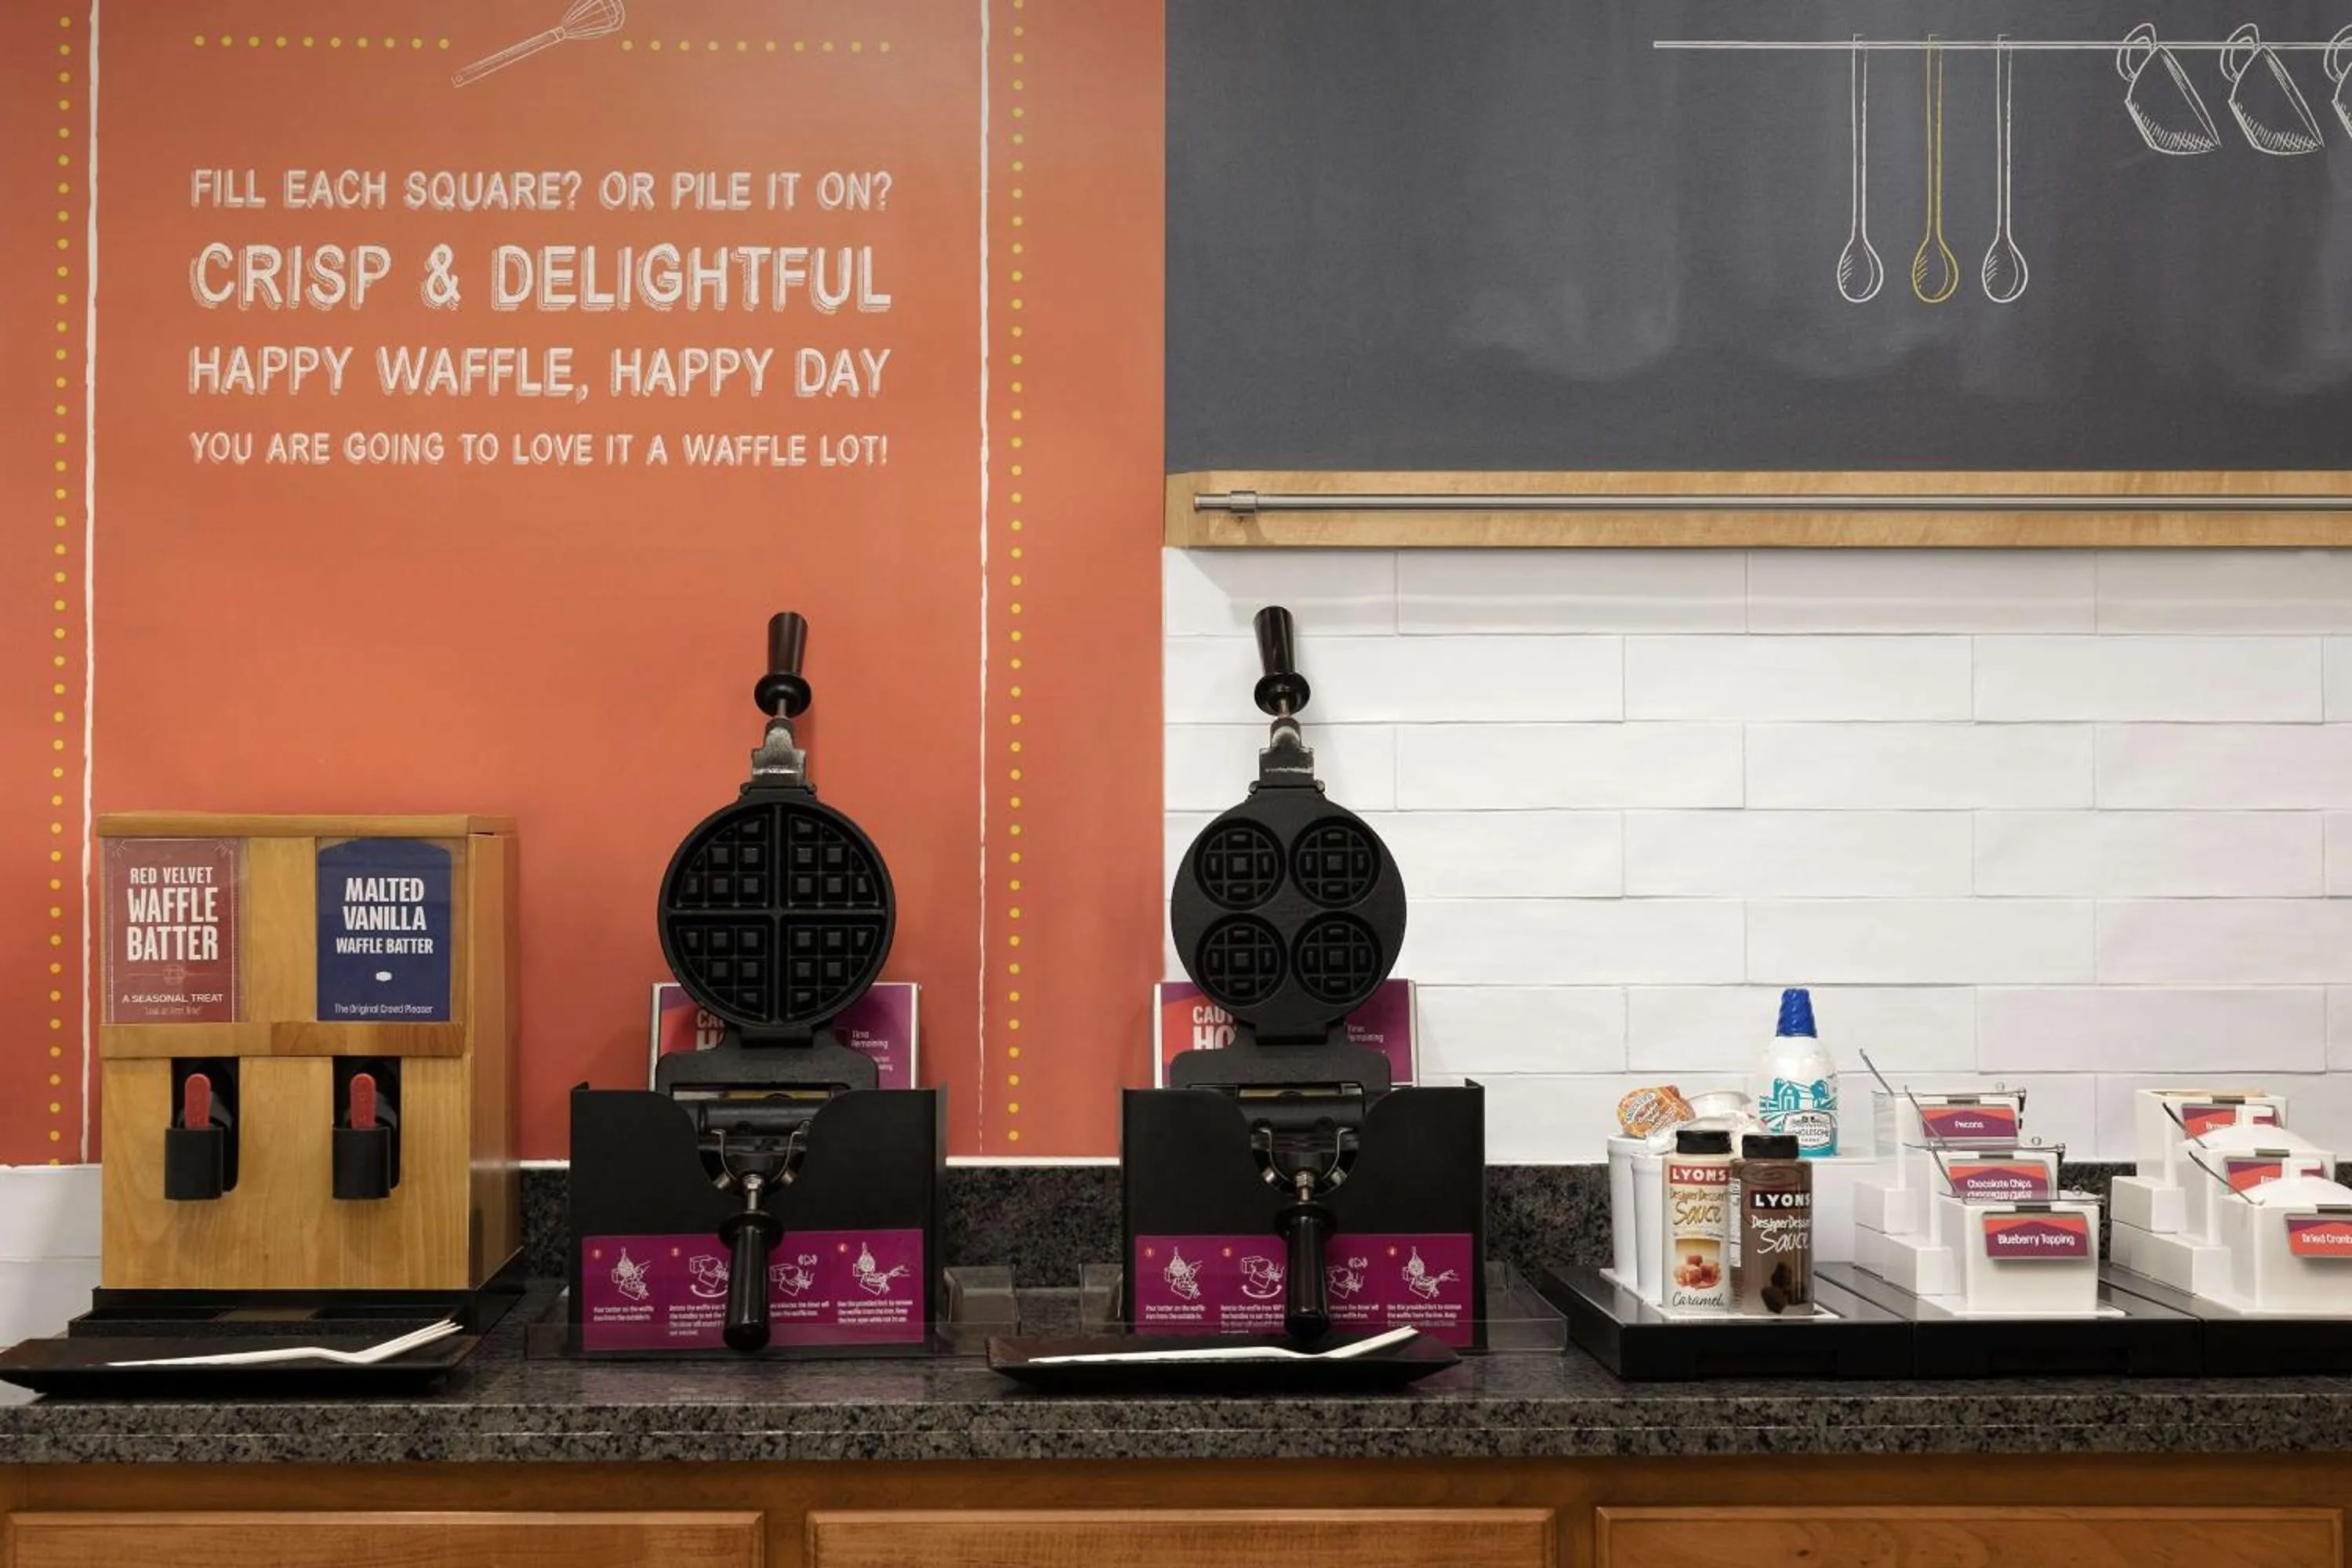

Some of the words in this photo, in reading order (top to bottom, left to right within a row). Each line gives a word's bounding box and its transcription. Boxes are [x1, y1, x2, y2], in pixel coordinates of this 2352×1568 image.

[193, 169, 265, 208] FILL
[283, 169, 387, 209] EACH
[403, 170, 582, 211] SQUARE?
[598, 171, 655, 210] OR
[671, 172, 753, 210] PILE
[767, 172, 801, 210] IT
[816, 171, 893, 211] ON?
[190, 241, 391, 310] CRISP
[421, 244, 461, 310] &
[491, 243, 891, 314] DELIGHTFUL
[189, 347, 353, 395] HAPPY
[376, 347, 589, 401] WAFFLE,
[610, 348, 775, 397] HAPPY
[795, 348, 891, 397] DAY
[191, 432, 252, 464] YOU
[265, 433, 330, 464] ARE
[343, 432, 445, 464] GOING
[459, 433, 499, 464] TO
[513, 434, 593, 465] LOVE
[606, 434, 633, 464] IT
[646, 434, 668, 464] A
[682, 434, 807, 466] WAFFLE
[819, 434, 887, 466] LOT!
[130, 868, 157, 884] RED
[163, 867, 213, 884] VELVET
[344, 877, 424, 902] MALTED
[127, 887, 219, 923] WAFFLE
[343, 906, 427, 931] VANILLA
[127, 926, 218, 960] BATTER
[336, 937, 383, 954] WAFFLE
[387, 938, 434, 954] BATTER
[131, 994, 188, 1003] SEASONAL
[191, 993, 223, 1003] TREAT
[334, 1004, 349, 1014] The
[1671, 1167, 1726, 1181] LYONS
[1966, 1178, 2009, 1189] Chocolate
[2009, 1178, 2032, 1190] Chips
[1672, 1200, 1722, 1225] Sauce
[1755, 1193, 1811, 1207] LYONS
[1756, 1229, 1809, 1254] Sauce
[1997, 1234, 2040, 1246] Blueberry
[2041, 1233, 2075, 1247] Topping
[1671, 1291, 1723, 1307] Caramel
